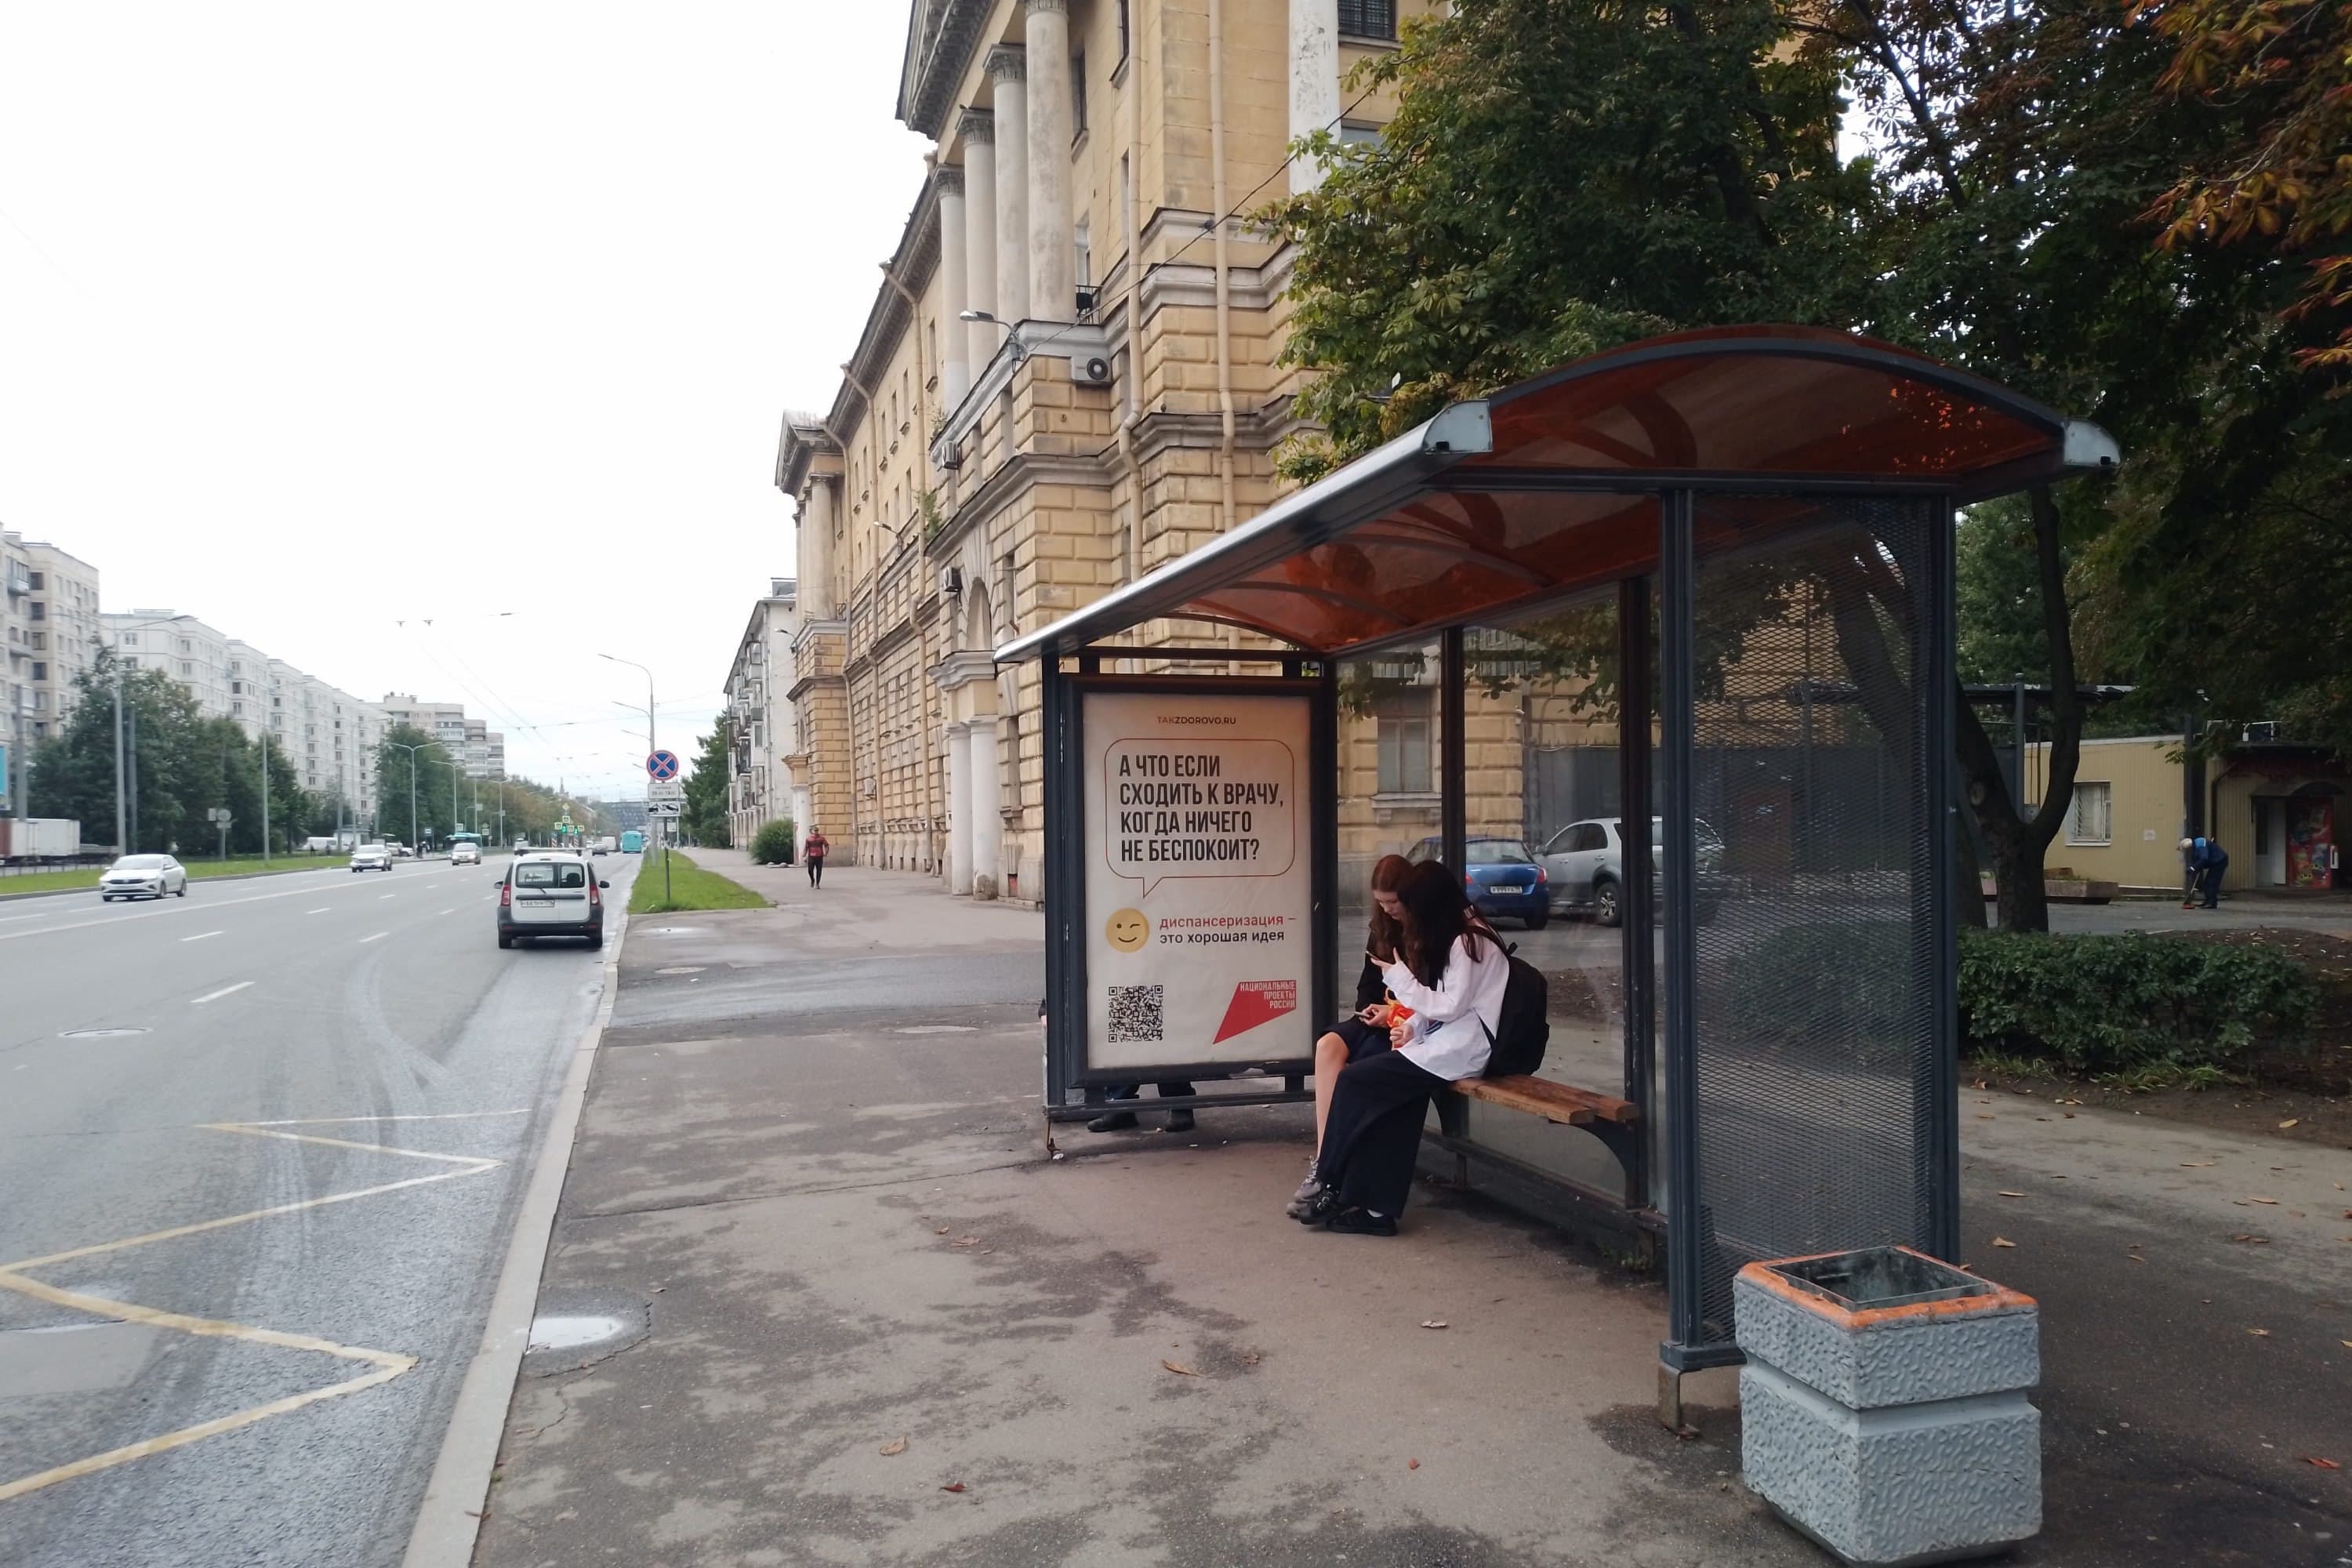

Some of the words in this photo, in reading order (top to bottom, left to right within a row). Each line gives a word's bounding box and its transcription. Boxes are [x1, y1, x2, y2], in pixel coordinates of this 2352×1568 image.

[1156, 716, 1236, 724] TAKZDOROVO.RU
[1120, 755, 1131, 777] А
[1136, 755, 1169, 777] ЧТО
[1174, 755, 1221, 777] ЕСЛИ
[1120, 783, 1203, 808] СХОДИТЬ
[1207, 783, 1219, 804] К
[1224, 783, 1284, 808] ВРАЧУ,
[1121, 811, 1180, 836] КОГДА
[1185, 811, 1252, 833] НИЧЕГО
[1122, 840, 1143, 862] НЕ
[1149, 839, 1260, 862] БЕСПОКОИТ?
[1160, 916, 1284, 931] диспансеризация
[1160, 934, 1183, 944] это
[1187, 931, 1248, 946] хорошая
[1252, 931, 1285, 943] идея
[1240, 982, 1296, 992] НАЦИОНАЛЬНЫЕ
[1264, 991, 1295, 1000] ПРОЕКТЫ
[1269, 1000, 1295, 1009] РОССИИ
